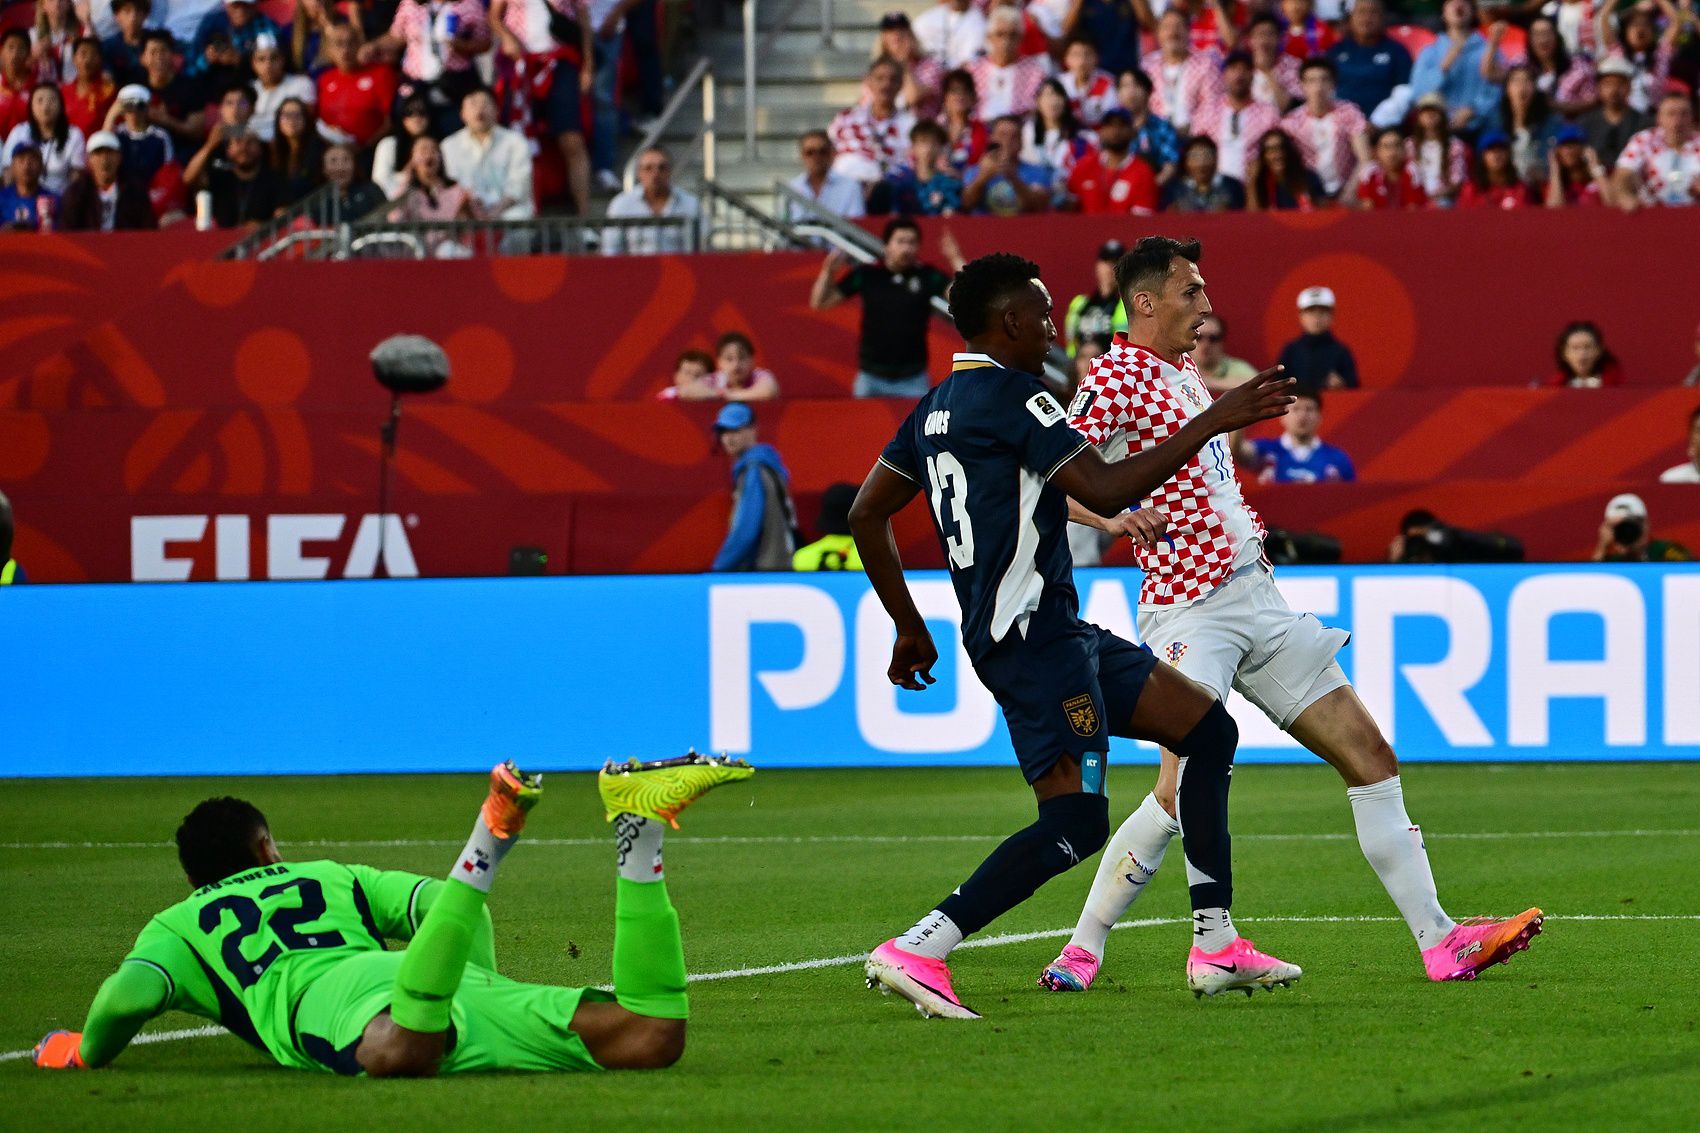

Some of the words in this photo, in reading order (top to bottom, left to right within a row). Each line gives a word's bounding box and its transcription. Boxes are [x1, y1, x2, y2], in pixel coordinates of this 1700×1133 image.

[1209, 440, 1230, 481] 11
[926, 451, 974, 571] 13
[131, 514, 419, 581] FIFA
[1065, 697, 1088, 708] PANAMA
[199, 877, 347, 992] 22
